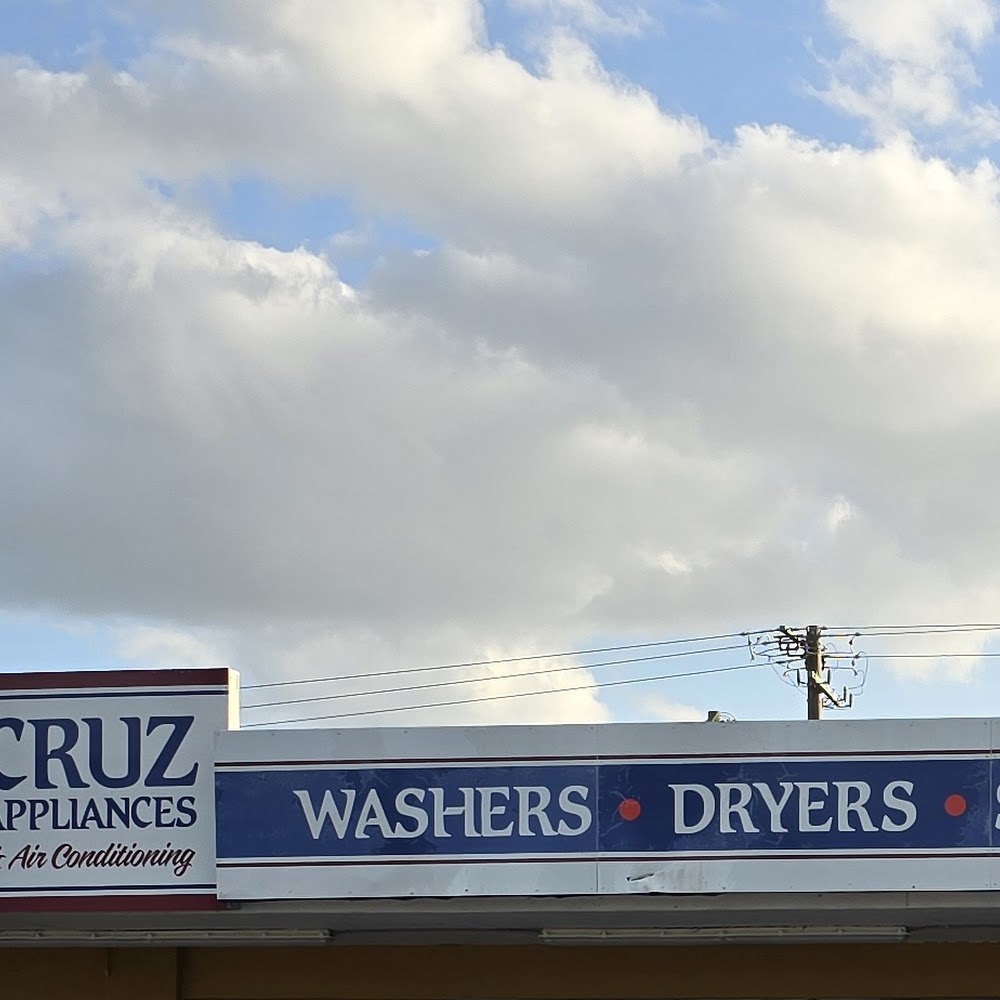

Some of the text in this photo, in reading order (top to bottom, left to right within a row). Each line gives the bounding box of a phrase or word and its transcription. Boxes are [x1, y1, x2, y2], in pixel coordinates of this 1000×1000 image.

[293, 785, 592, 840] WASHERS
[668, 780, 917, 834] DRYERS
[8, 844, 48, 870] Air
[52, 842, 195, 877] Conditioning
